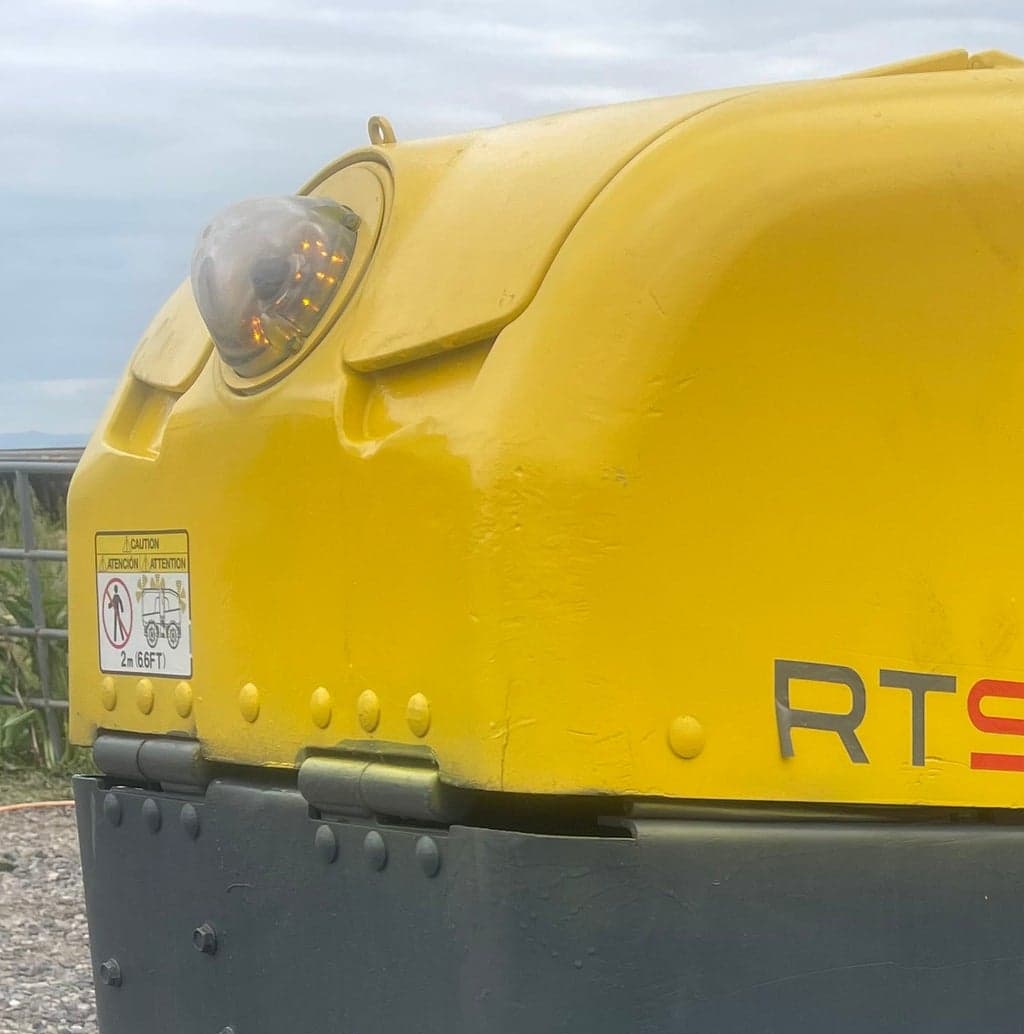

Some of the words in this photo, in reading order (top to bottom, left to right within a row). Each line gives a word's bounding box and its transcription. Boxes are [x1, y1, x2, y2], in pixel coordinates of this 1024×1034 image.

[130, 538, 160, 550] CAUTION
[107, 556, 139, 570] ATENCIÓN
[150, 557, 186, 570] ATTENTION
